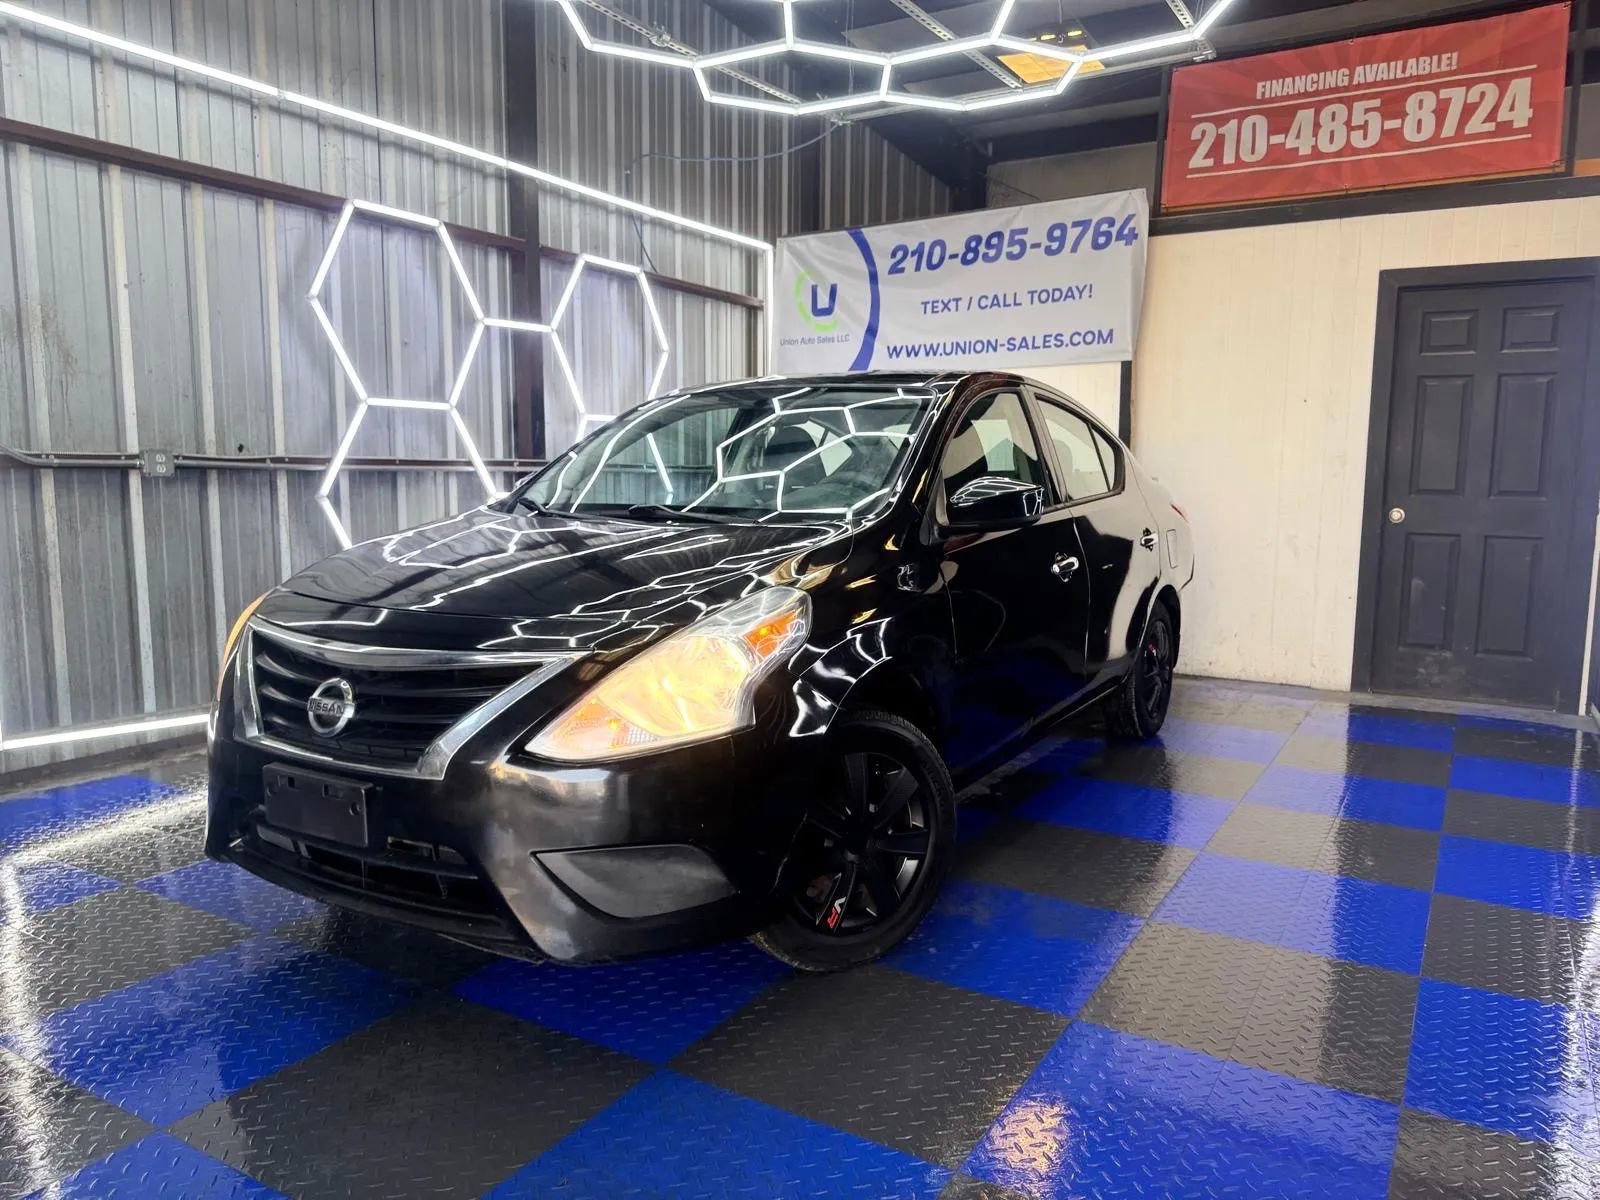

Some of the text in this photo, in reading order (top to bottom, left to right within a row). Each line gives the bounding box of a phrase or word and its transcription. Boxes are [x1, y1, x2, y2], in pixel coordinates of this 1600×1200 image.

[1256, 52, 1459, 99] FINANCING AVAILABLE!
[1188, 77, 1533, 169] 210-485-8724
[887, 213, 1139, 275] 210-895-9764
[921, 284, 1094, 315] TEXT / CALL TODAY!
[780, 334, 850, 346] Union Auto Sales LLC
[887, 328, 1114, 359] WWW.UNION-SALES.COM
